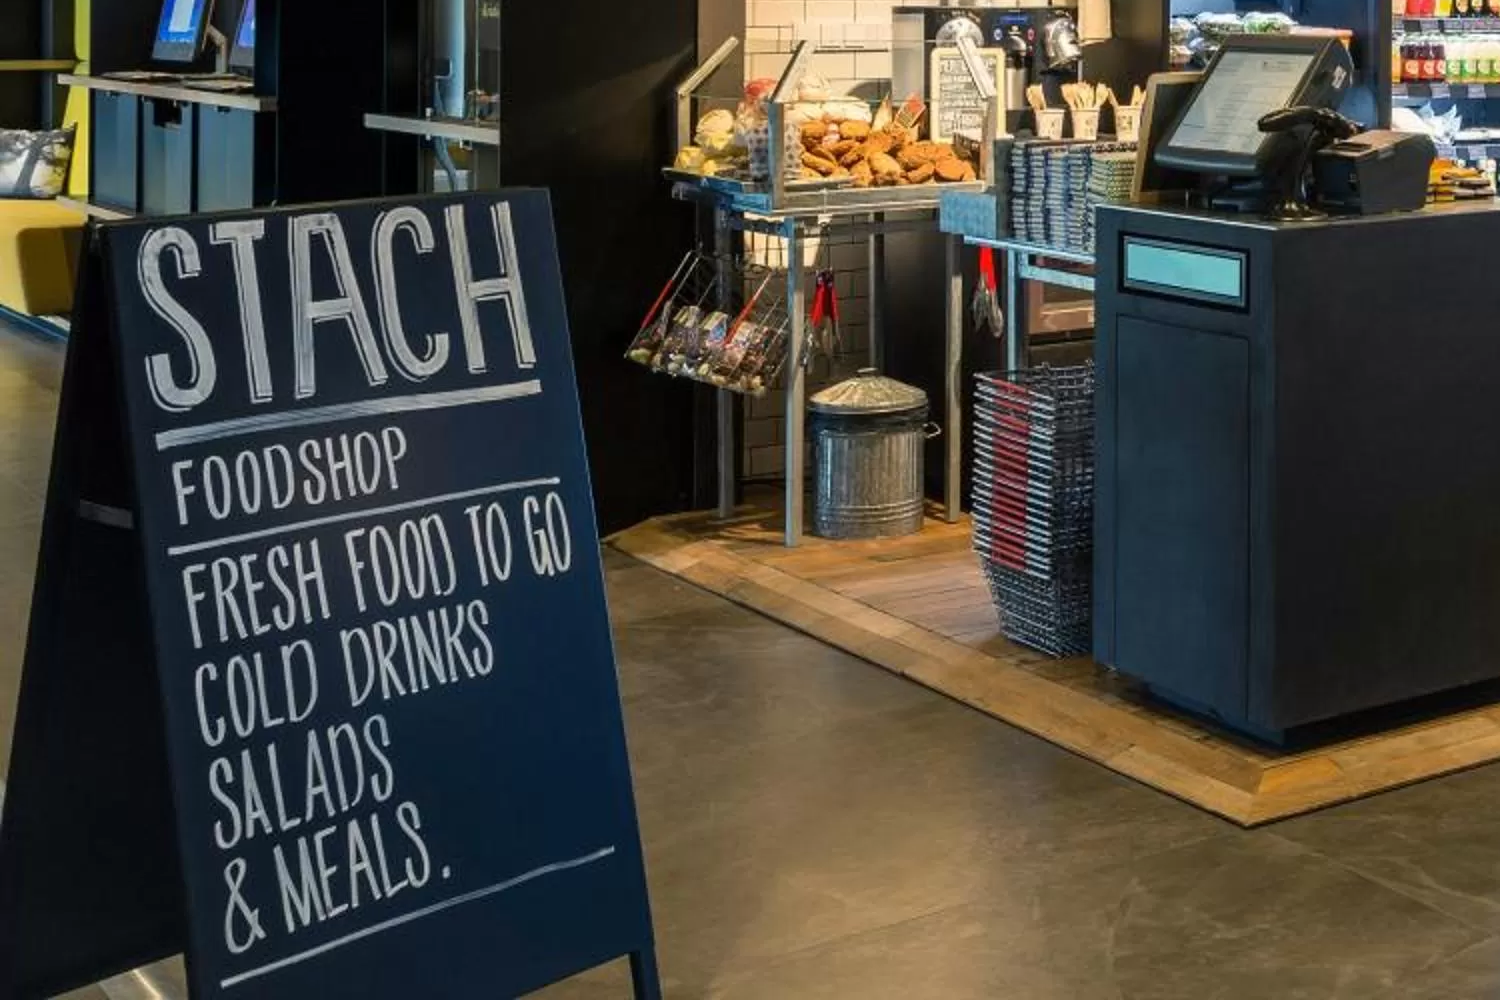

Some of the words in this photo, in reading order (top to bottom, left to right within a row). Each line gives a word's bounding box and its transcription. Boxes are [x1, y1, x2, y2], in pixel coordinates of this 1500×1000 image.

[138, 201, 538, 412] STACH
[173, 426, 407, 525] FOODSHOP
[182, 537, 331, 649] FRESH
[345, 512, 456, 612] FOOD
[465, 502, 511, 587] TO
[524, 491, 572, 577] GO
[194, 639, 319, 747] COLD
[340, 600, 493, 708] DRINKS
[209, 714, 394, 849] SALADS
[223, 857, 267, 954] &
[273, 801, 451, 934] MEALS.
